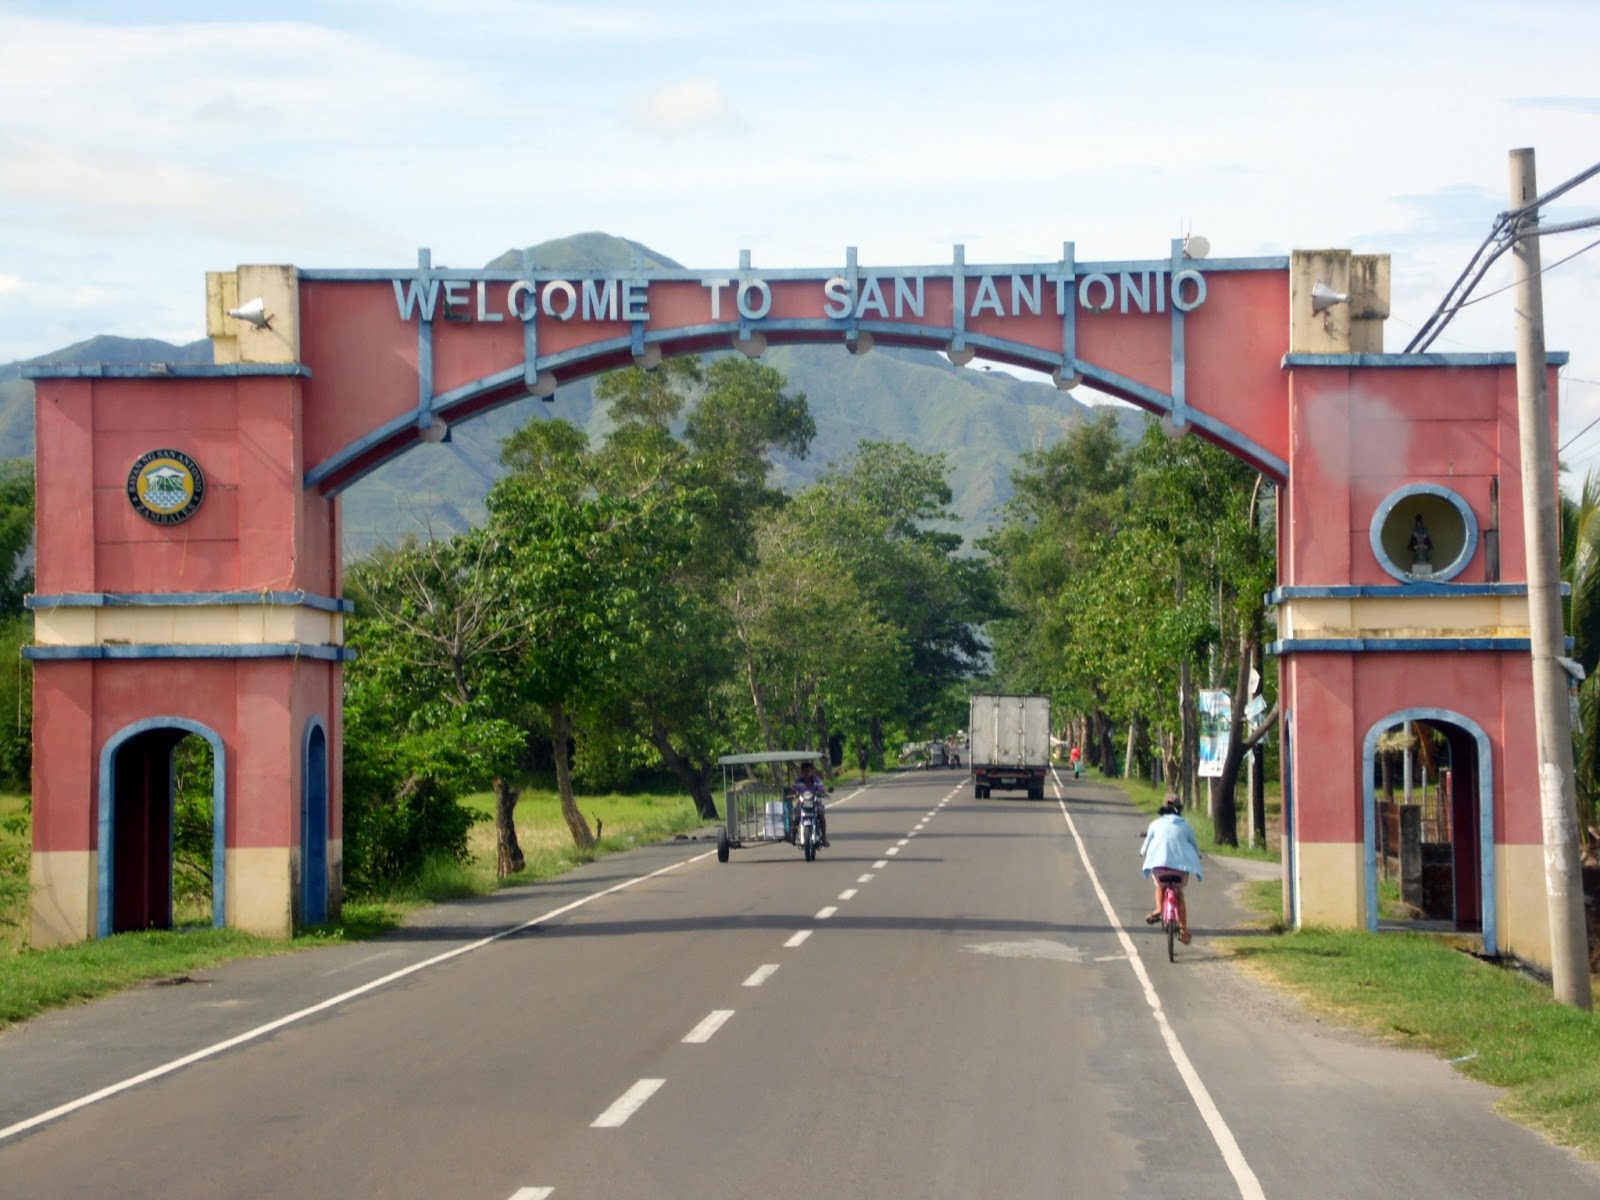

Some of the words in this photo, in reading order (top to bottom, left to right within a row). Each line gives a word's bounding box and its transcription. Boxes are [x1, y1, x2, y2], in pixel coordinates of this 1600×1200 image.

[392, 279, 650, 322] WELCOME
[701, 278, 772, 320] TO
[823, 274, 925, 319] SAN
[970, 268, 1207, 317] ANTONIO
[157, 450, 176, 459] SAN
[179, 454, 202, 492] ANTONIO
[136, 503, 197, 523] ZAMBALES
